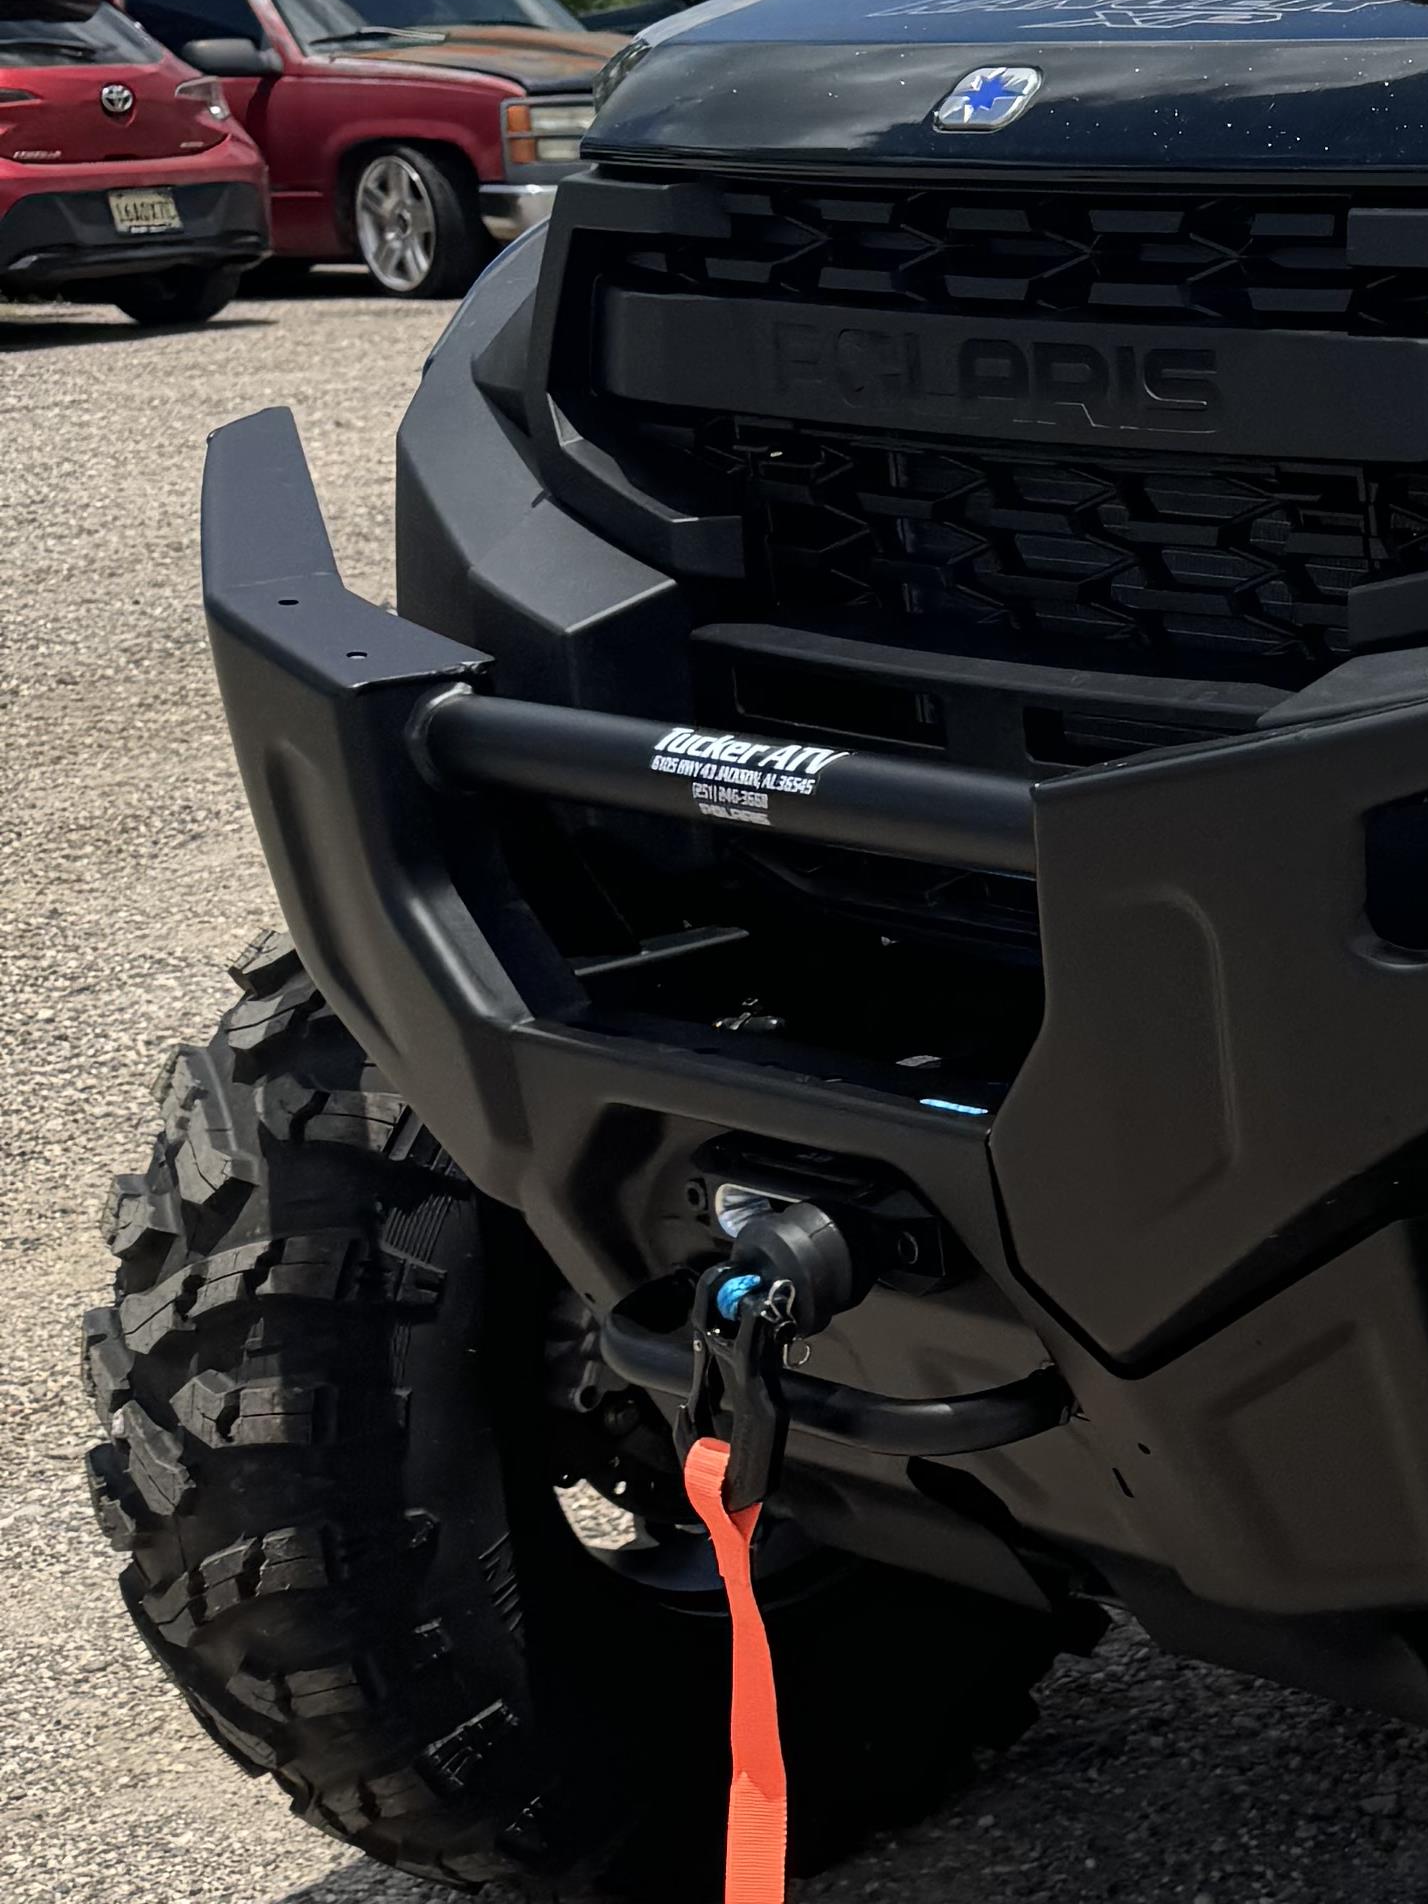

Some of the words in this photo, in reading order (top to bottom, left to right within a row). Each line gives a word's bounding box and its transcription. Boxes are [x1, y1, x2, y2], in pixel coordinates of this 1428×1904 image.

[1017, 10, 1283, 29] XP
[772, 322, 1222, 433] POLARIS
[653, 727, 771, 764] Tucker
[758, 745, 850, 775] ATV
